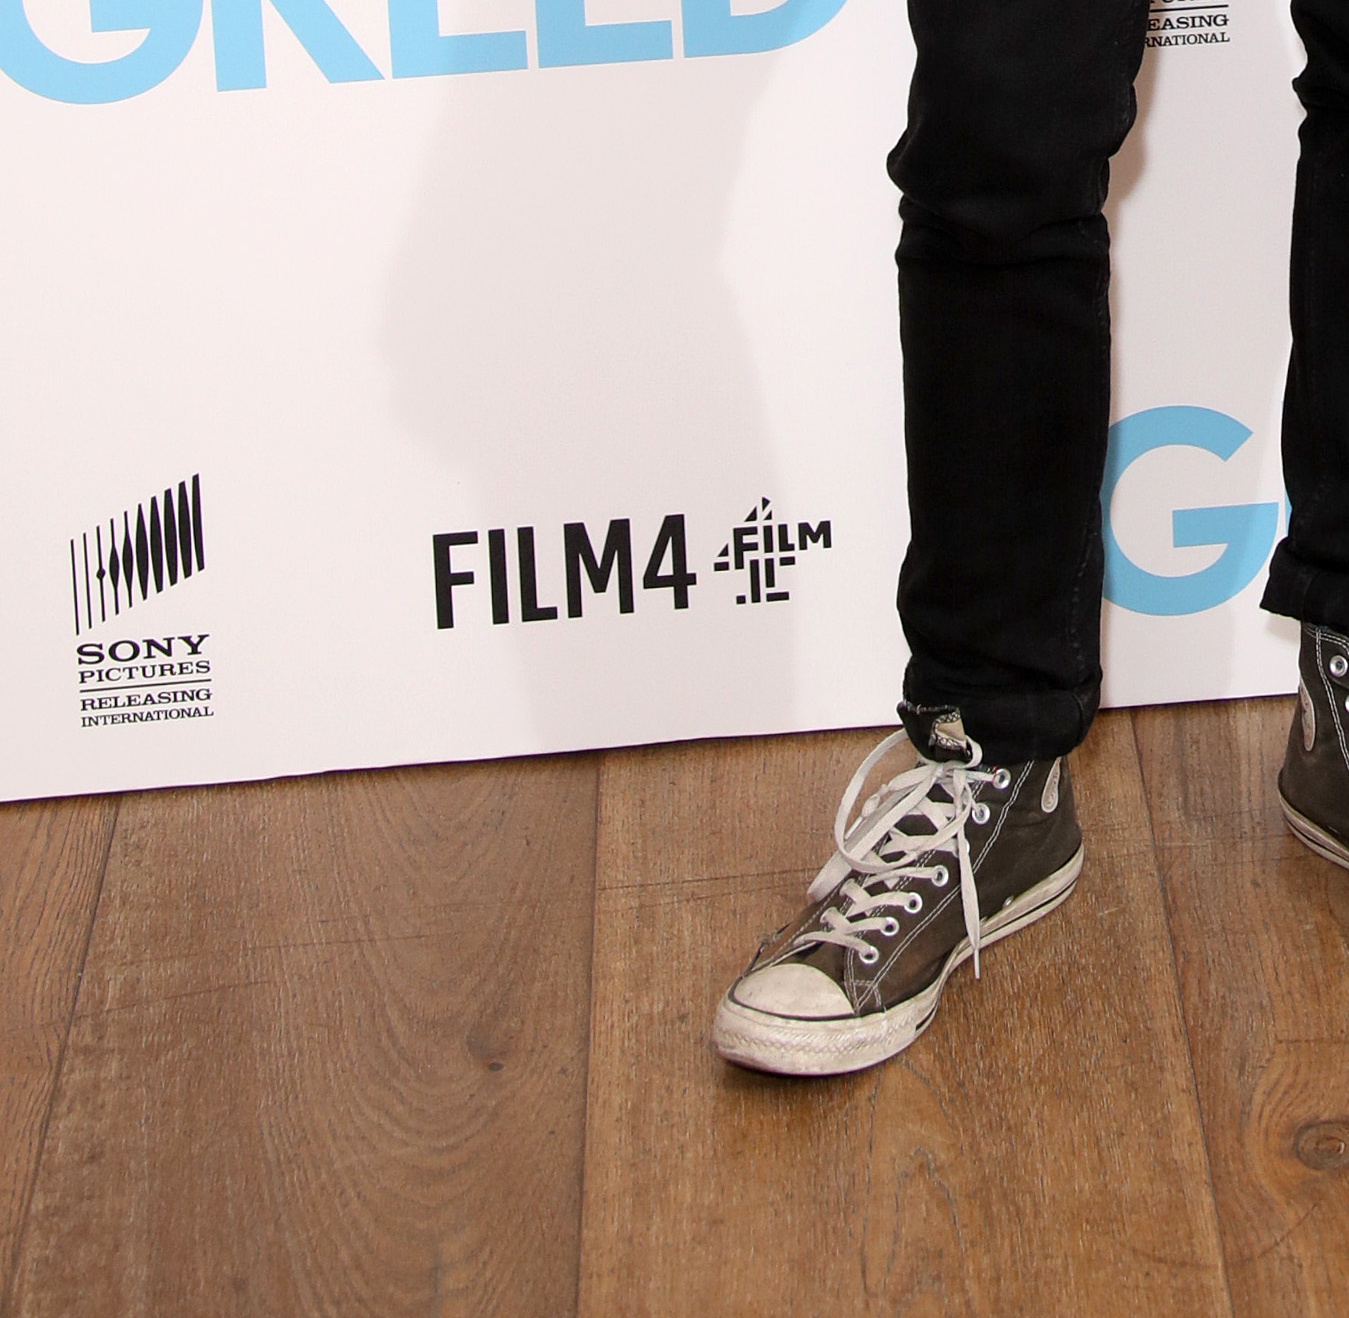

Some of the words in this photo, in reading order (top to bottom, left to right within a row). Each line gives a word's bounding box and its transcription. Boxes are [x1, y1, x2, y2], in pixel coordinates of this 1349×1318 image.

[1148, 14, 1230, 32] EASING
[432, 513, 697, 630] FILM4
[75, 634, 210, 666] SONY
[78, 660, 211, 685] PICTURES
[80, 688, 212, 712] RELEASING
[81, 706, 215, 728] INTERNATIONAL
